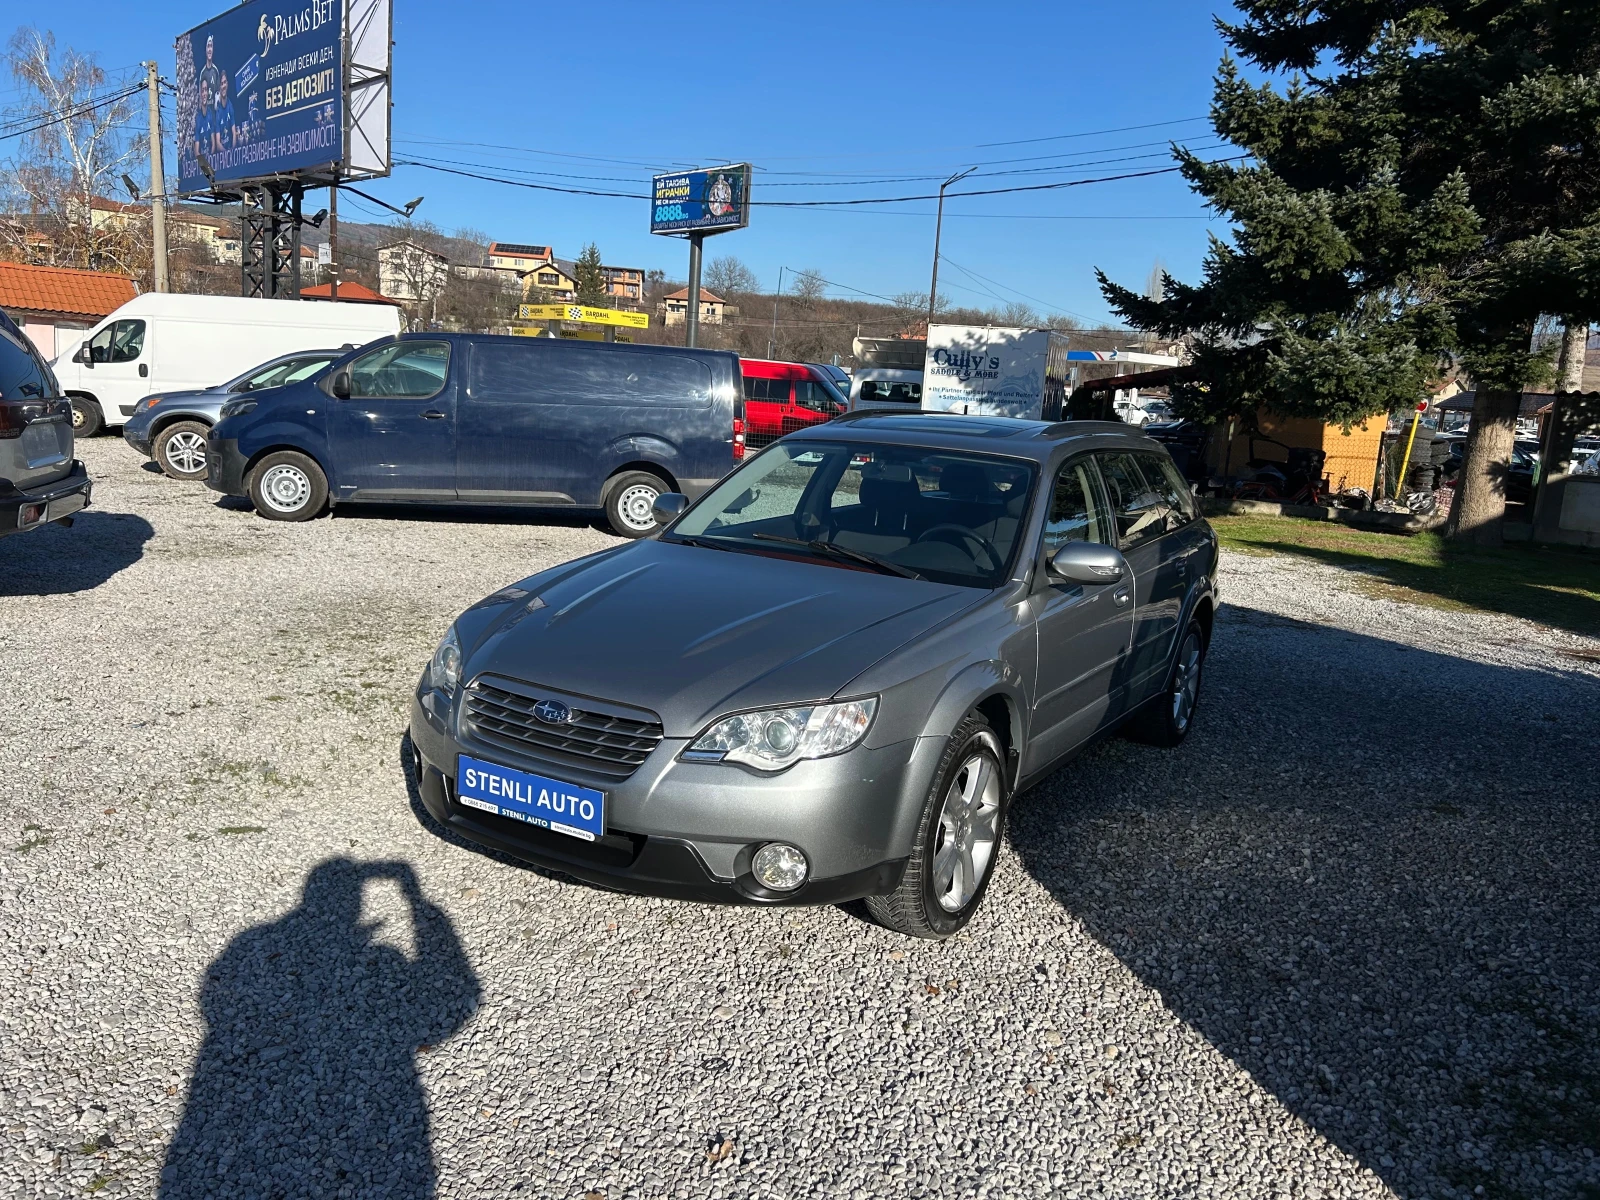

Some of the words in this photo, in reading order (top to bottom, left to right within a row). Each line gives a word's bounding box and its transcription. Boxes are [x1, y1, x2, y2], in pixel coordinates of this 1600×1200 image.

[274, 8, 310, 45] PALMS
[311, 0, 335, 30] BET
[265, 58, 297, 81] ИЗНЕНАДИ
[298, 50, 318, 70] ВСЕКИ
[266, 85, 283, 110] БЕЗ
[284, 68, 334, 107] ДЕПОЗИТ!
[234, 147, 242, 166] ОТ
[242, 139, 277, 165] РАЗВИВАНЕ
[278, 136, 287, 157] НА
[287, 124, 336, 156] ЗАВИСИМОСТ!
[656, 180, 664, 189] ЕЙ
[666, 178, 690, 188] ТАКИВА
[656, 186, 690, 198] ИГРАЧКИ
[586, 310, 610, 320] BARDAHL
[930, 368, 961, 376] SADDLE
[465, 768, 532, 804] STENLI
[536, 788, 595, 820] AUTO
[502, 808, 526, 820] STENLI
[526, 816, 548, 827] AUTO
